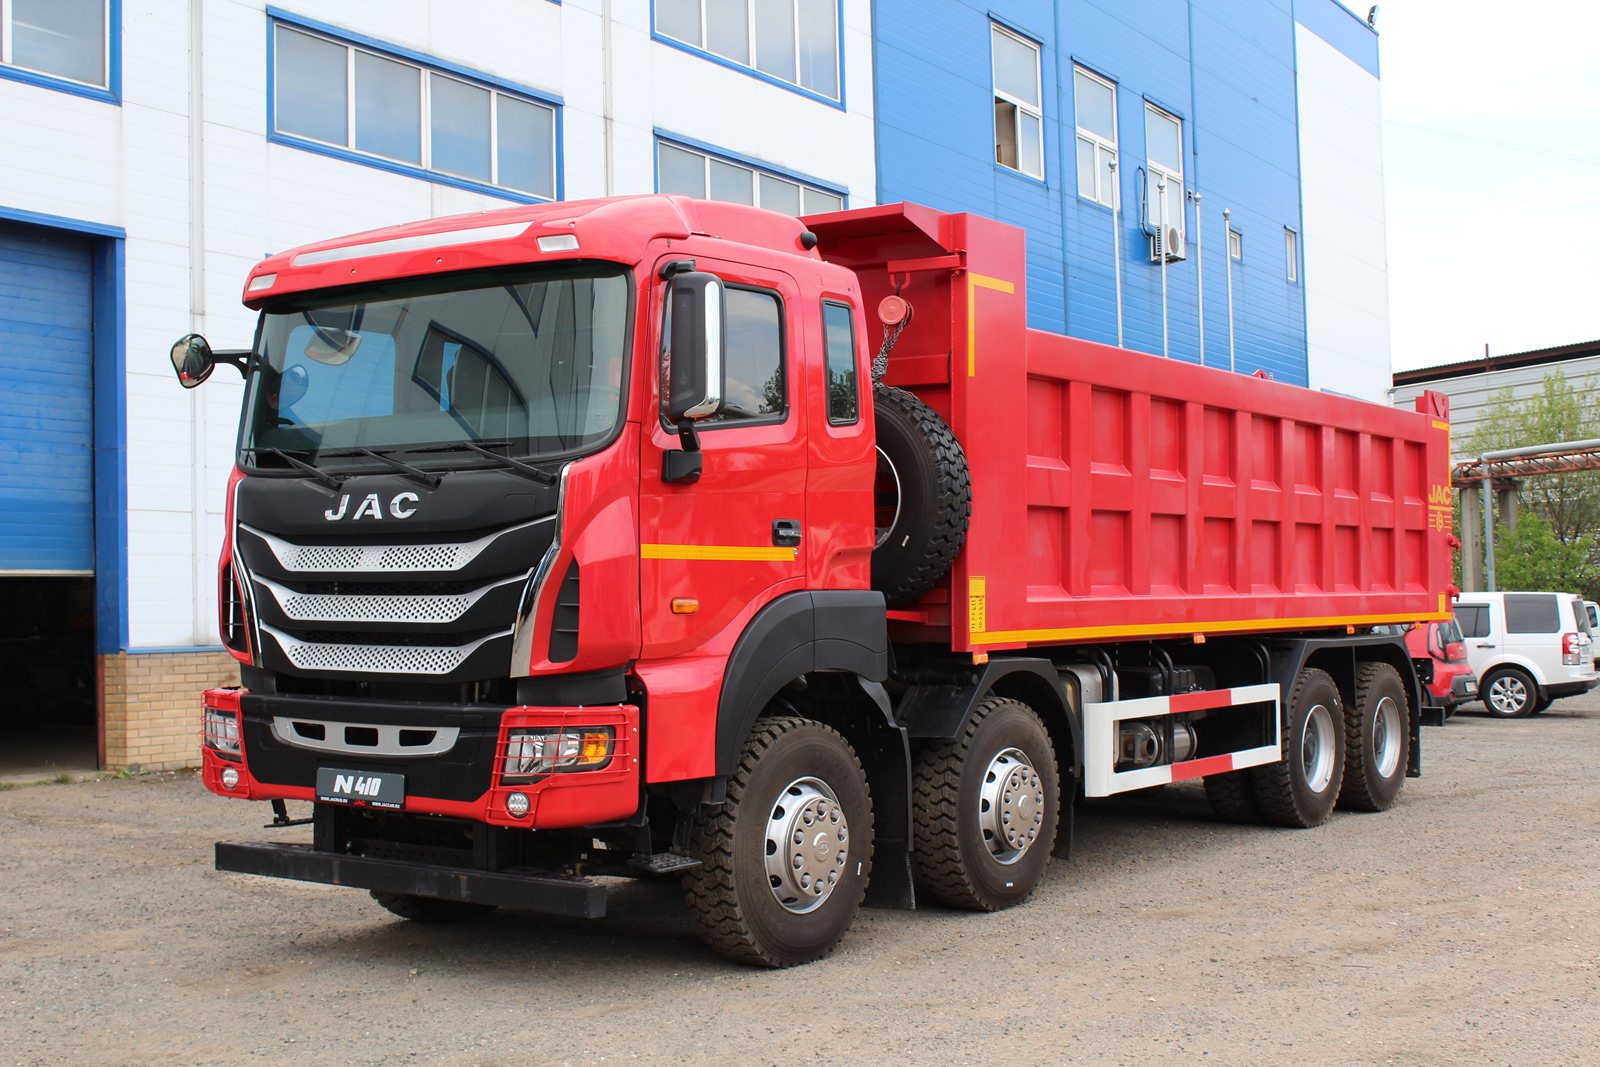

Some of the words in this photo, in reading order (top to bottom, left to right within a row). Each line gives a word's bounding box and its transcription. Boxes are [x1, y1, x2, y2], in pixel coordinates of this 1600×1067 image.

[1428, 484, 1451, 504] JAC
[324, 491, 419, 521] JAC
[333, 774, 355, 794] N
[354, 776, 382, 796] 410
